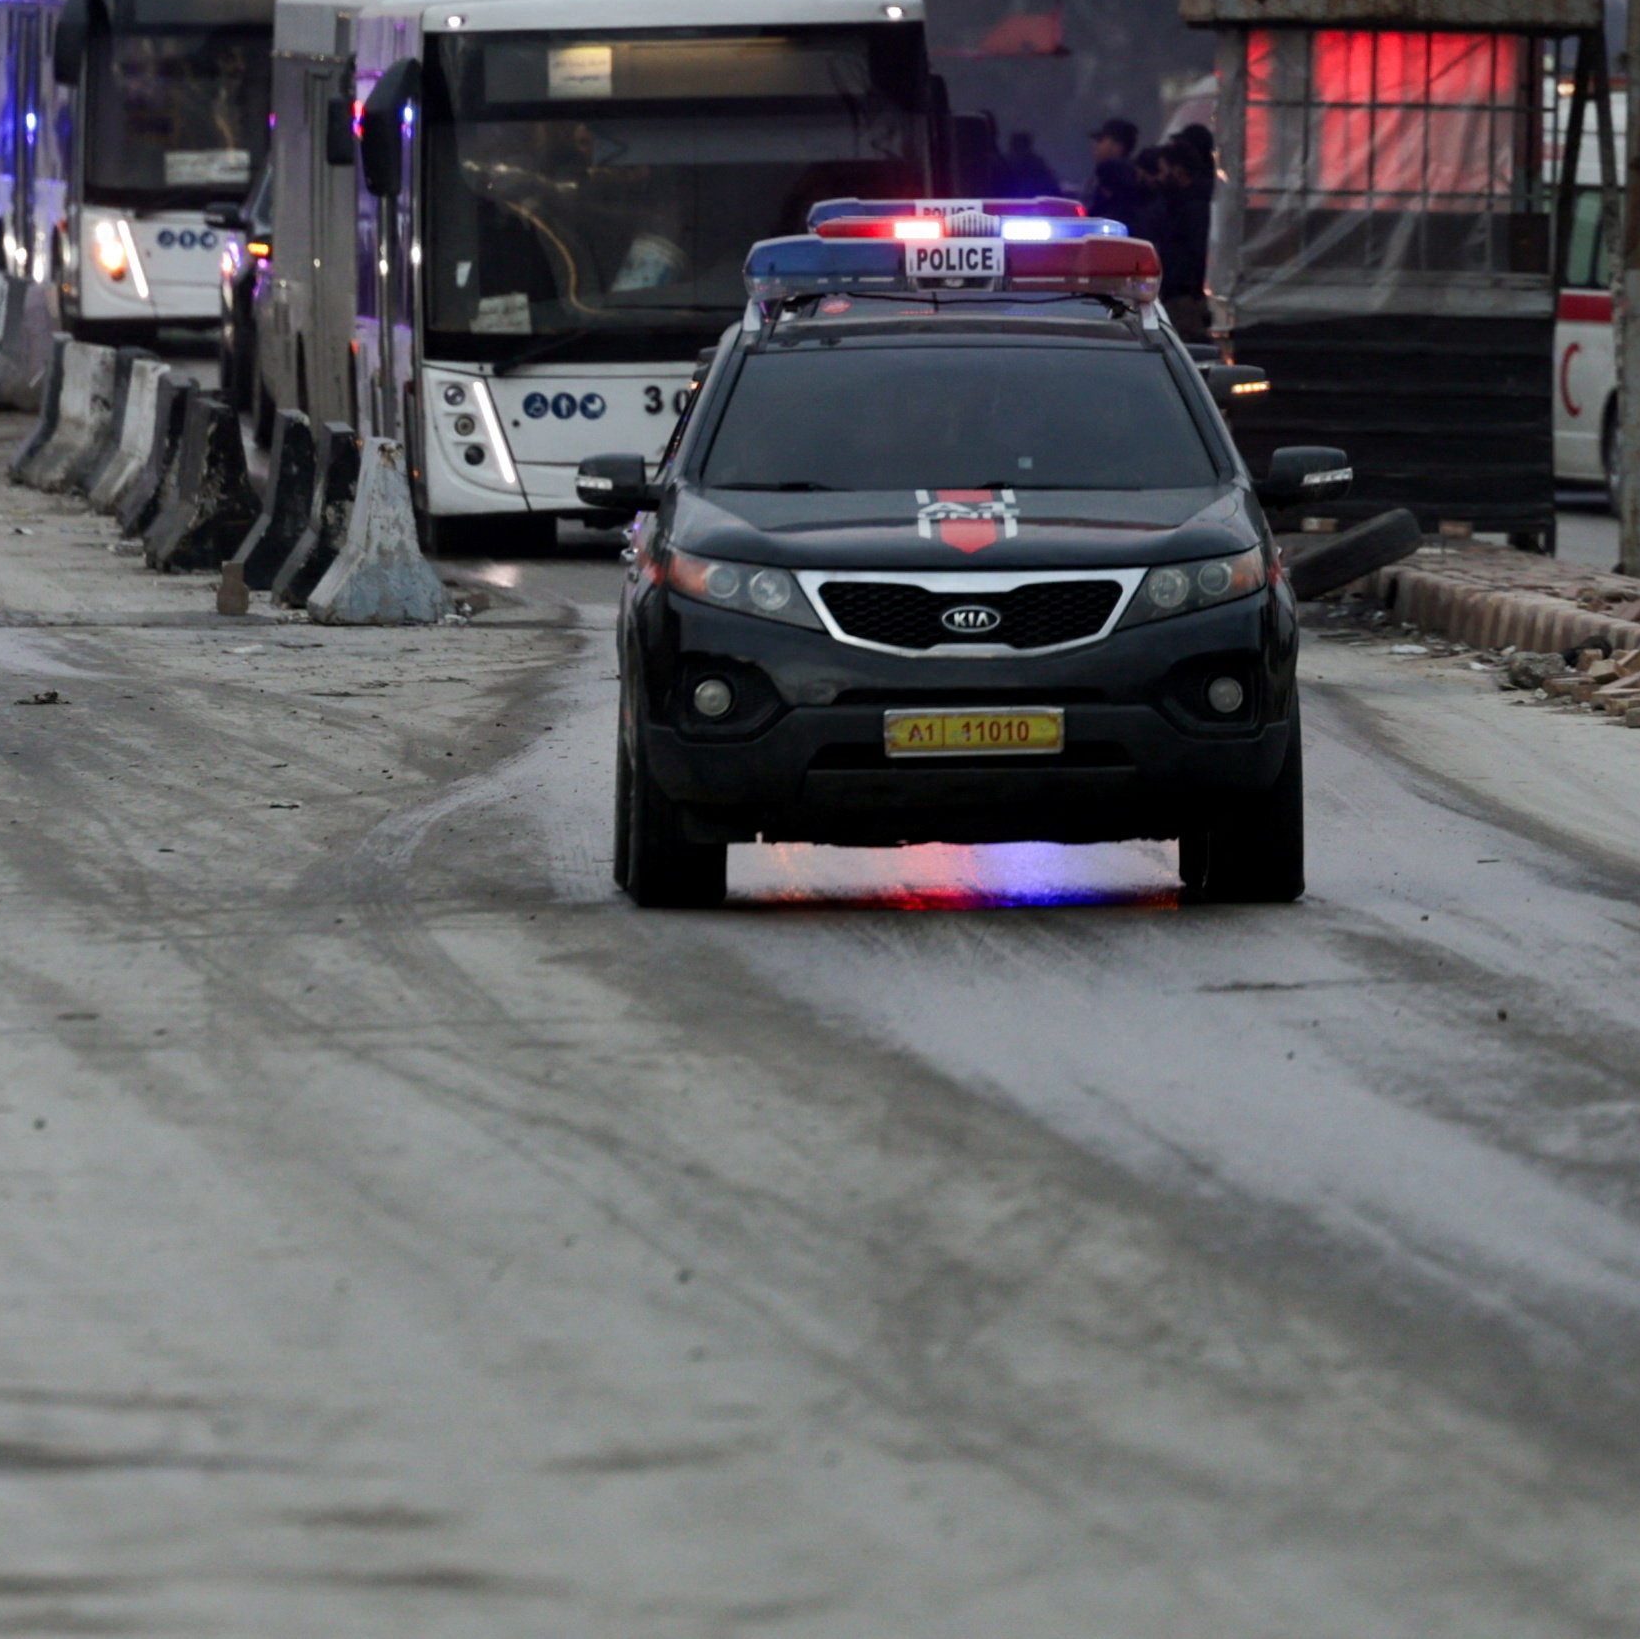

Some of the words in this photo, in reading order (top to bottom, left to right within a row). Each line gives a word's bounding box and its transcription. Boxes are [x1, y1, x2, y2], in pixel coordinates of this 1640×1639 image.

[916, 247, 994, 271] POLICE
[954, 610, 989, 627] KIA
[908, 724, 934, 742] A1
[961, 721, 1030, 743] 11010
